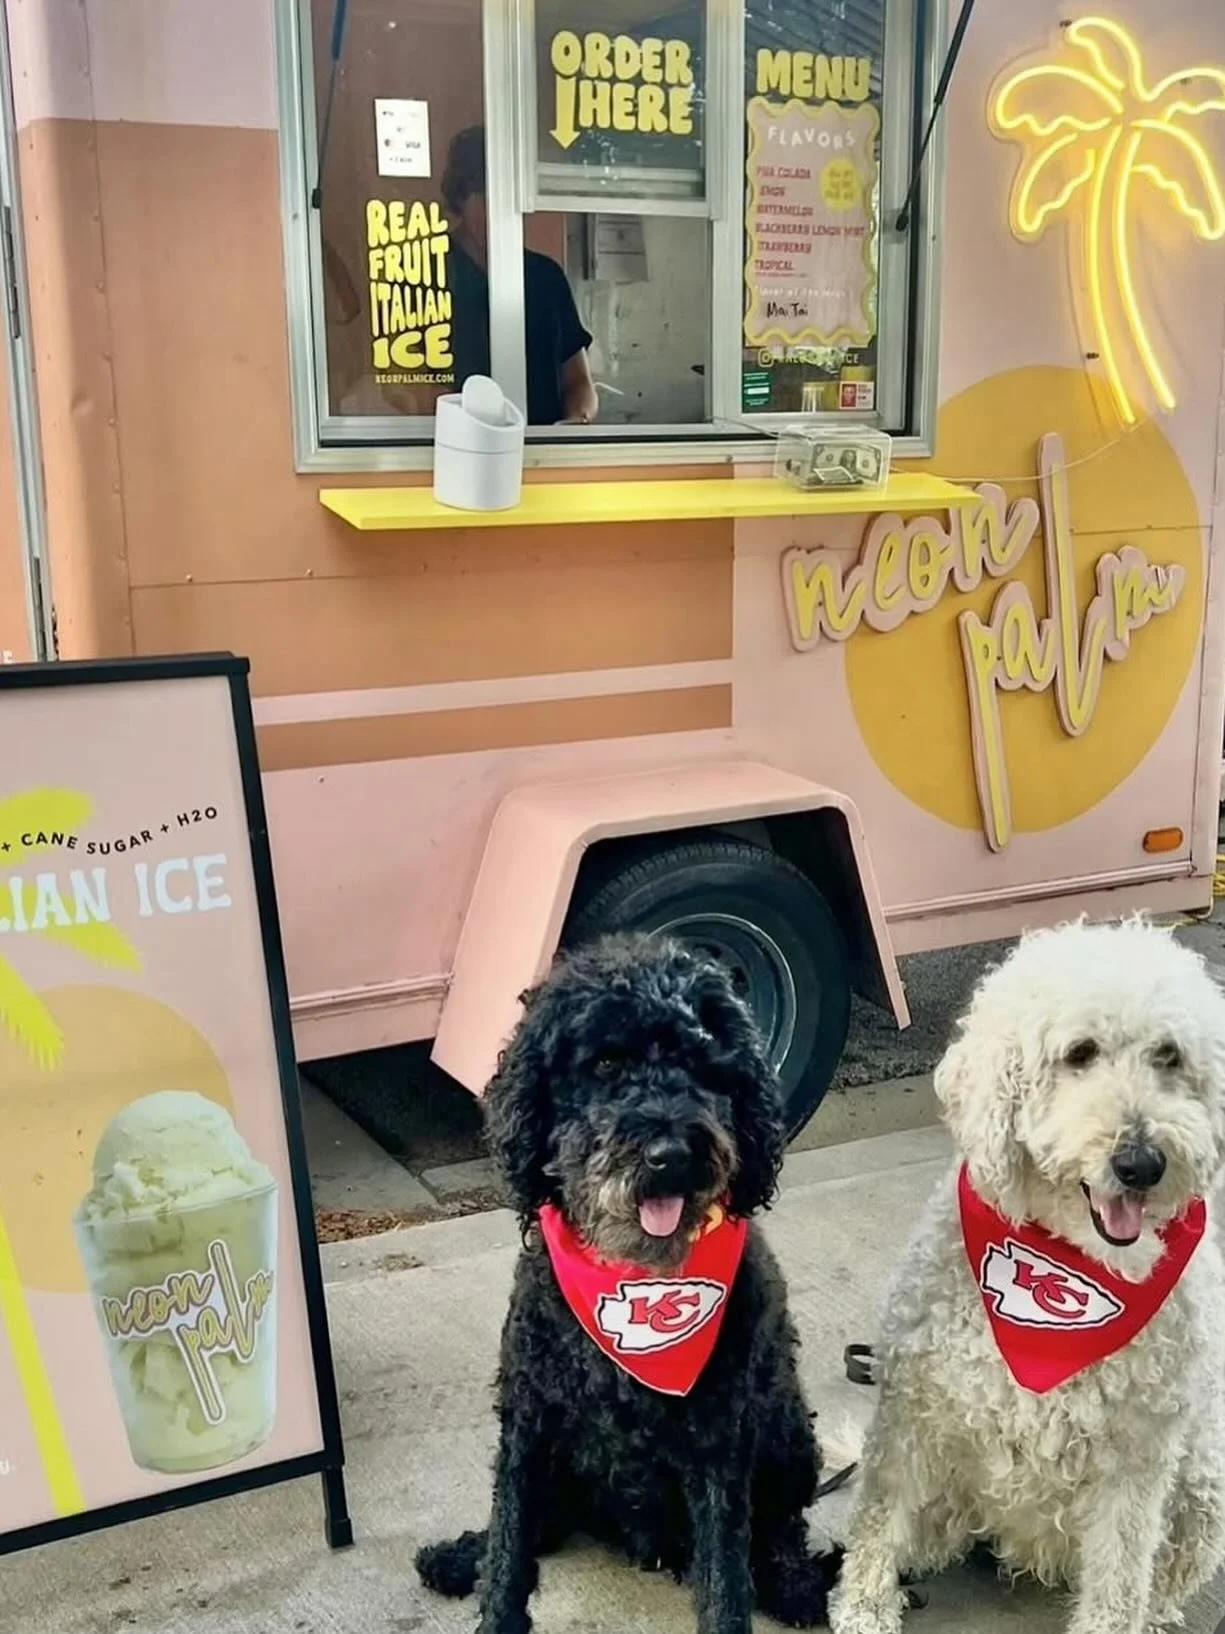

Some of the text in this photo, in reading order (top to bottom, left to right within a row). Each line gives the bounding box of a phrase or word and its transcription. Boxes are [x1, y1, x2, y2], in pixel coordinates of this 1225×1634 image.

[550, 30, 693, 85] ORDER
[756, 48, 871, 102] MENU
[578, 79, 693, 135] HERE
[767, 125, 856, 151] FLAVORS
[778, 166, 811, 179] COLADA
[366, 200, 448, 248] REAL
[369, 234, 450, 288] FRUIT
[755, 259, 794, 271] TROPICAL
[370, 283, 452, 337] ITALIAN
[767, 302, 789, 318] Mai
[373, 325, 454, 369] ICE
[784, 484, 1038, 650] neon
[960, 433, 1184, 851] palm
[21, 831, 79, 850] CANE
[86, 829, 154, 856] SUGAR
[176, 806, 218, 828] H2O
[135, 853, 232, 918] ICE
[102, 1268, 214, 1342] neon
[628, 1289, 701, 1334] KC
[1012, 1258, 1089, 1319] KC
